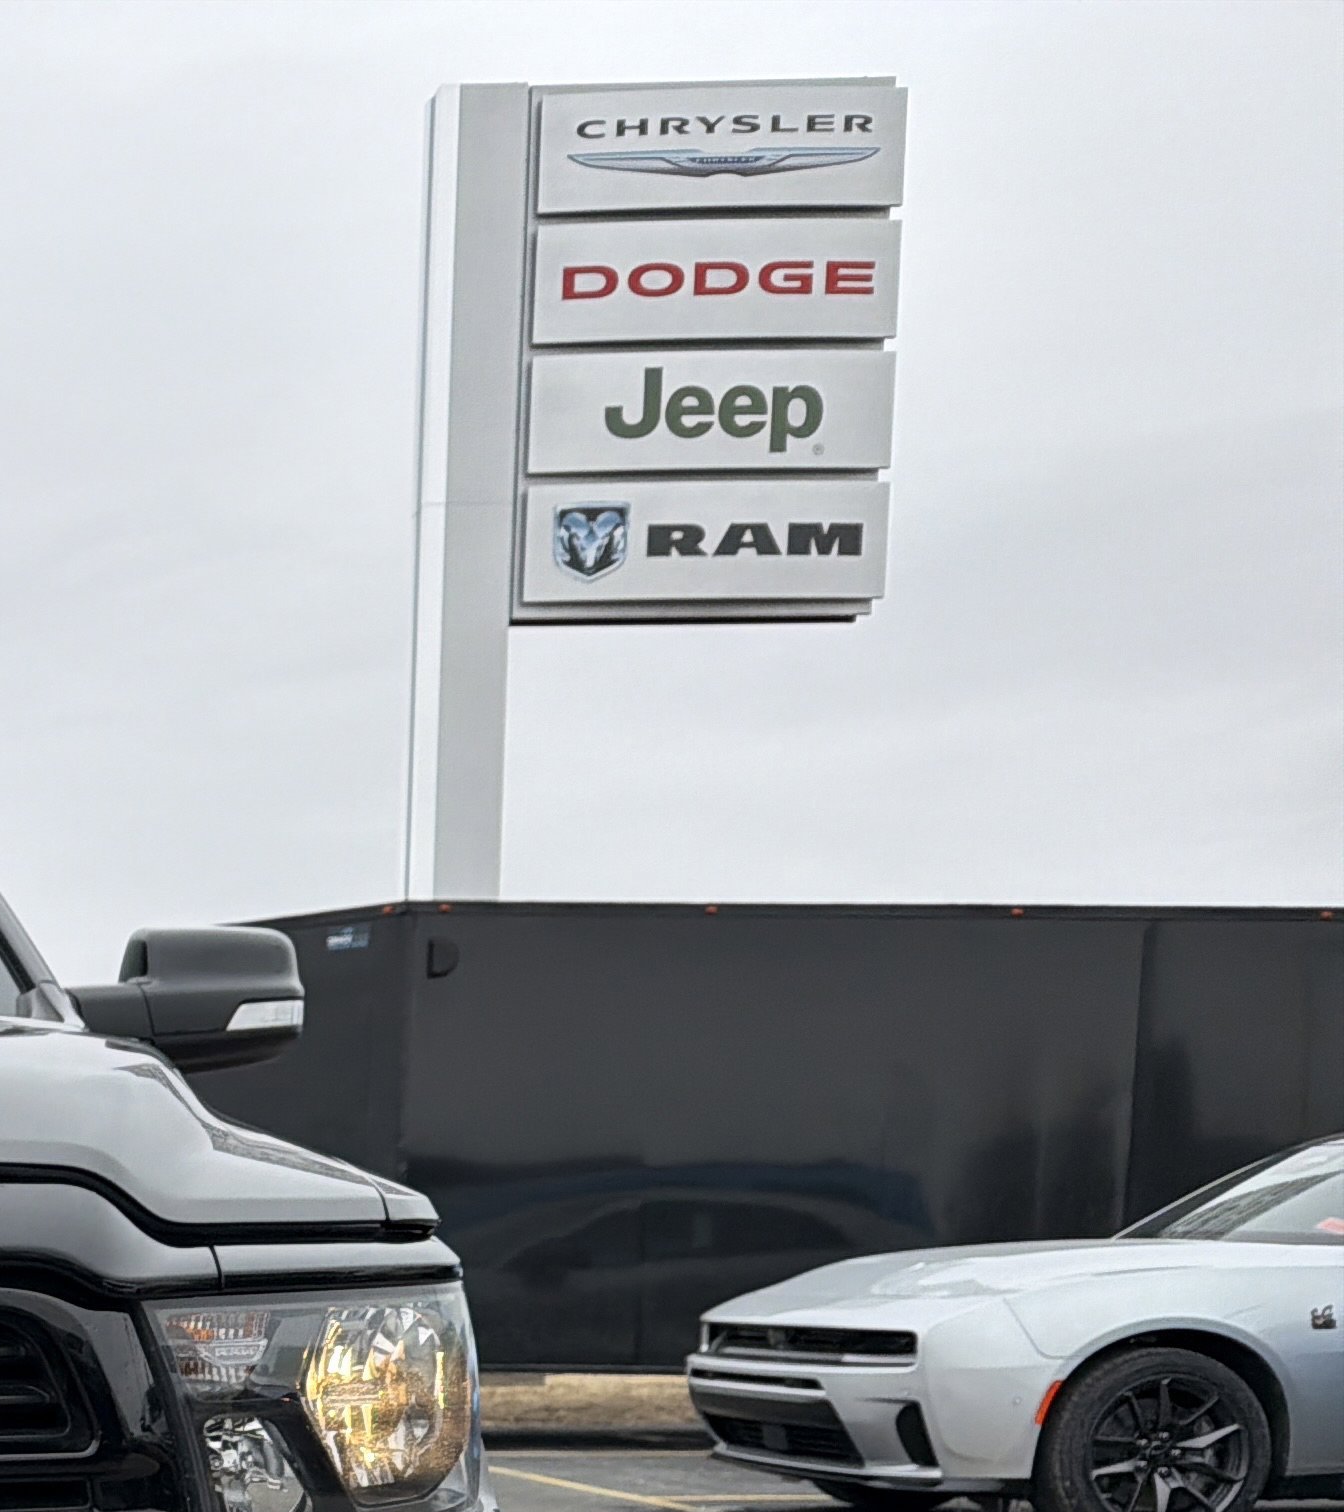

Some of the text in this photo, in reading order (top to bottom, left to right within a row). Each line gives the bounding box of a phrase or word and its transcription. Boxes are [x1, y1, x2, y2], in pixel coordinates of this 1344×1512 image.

[576, 113, 874, 140] CHRYSLER
[561, 260, 876, 301] DODGE
[604, 366, 824, 453] Jeep
[645, 522, 864, 558] RAM
